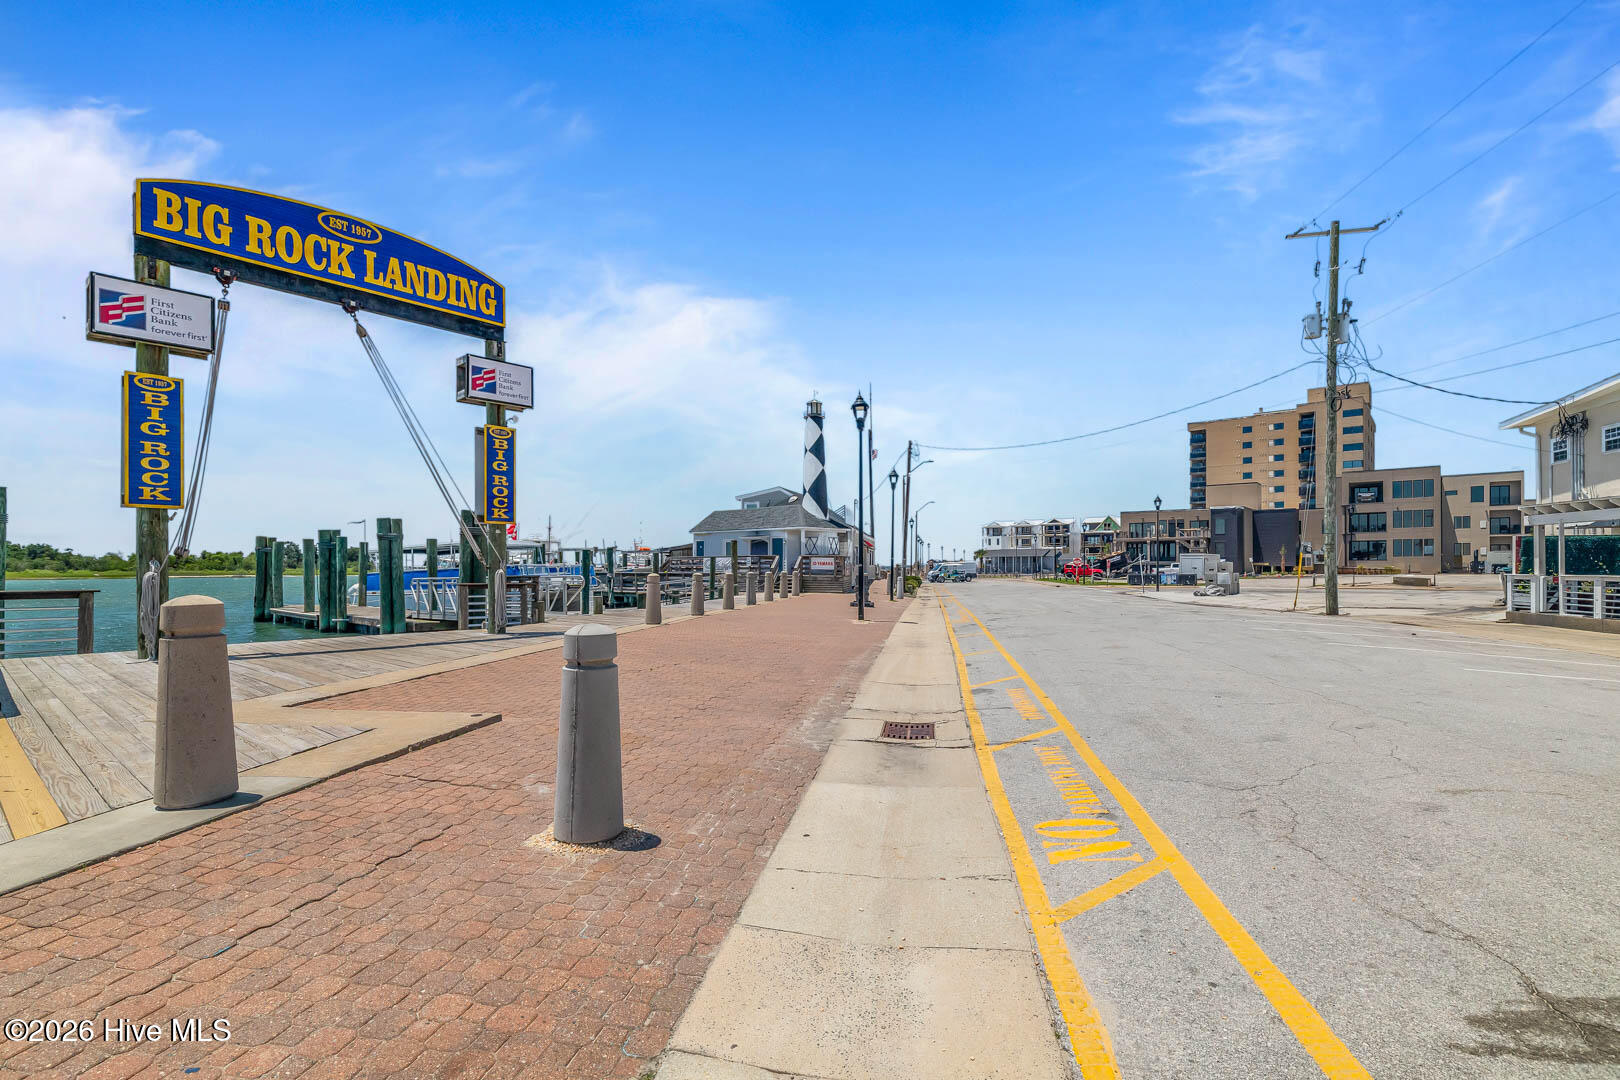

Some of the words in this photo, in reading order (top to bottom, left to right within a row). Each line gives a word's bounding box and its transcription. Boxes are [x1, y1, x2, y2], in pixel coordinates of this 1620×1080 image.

[329, 216, 348, 232] EST
[351, 224, 372, 238] 1957
[153, 187, 233, 247] BIG
[245, 214, 356, 280] ROCK
[363, 249, 497, 316] LANDING
[151, 298, 174, 309] First
[151, 306, 193, 321] Citizens
[151, 315, 178, 327] Bank
[151, 325, 186, 338] forever
[140, 390, 170, 437] BIG
[138, 440, 172, 501] ROCK
[492, 438, 509, 471] BIG
[491, 474, 510, 519] ROCK
[1033, 818, 1145, 865] NO
